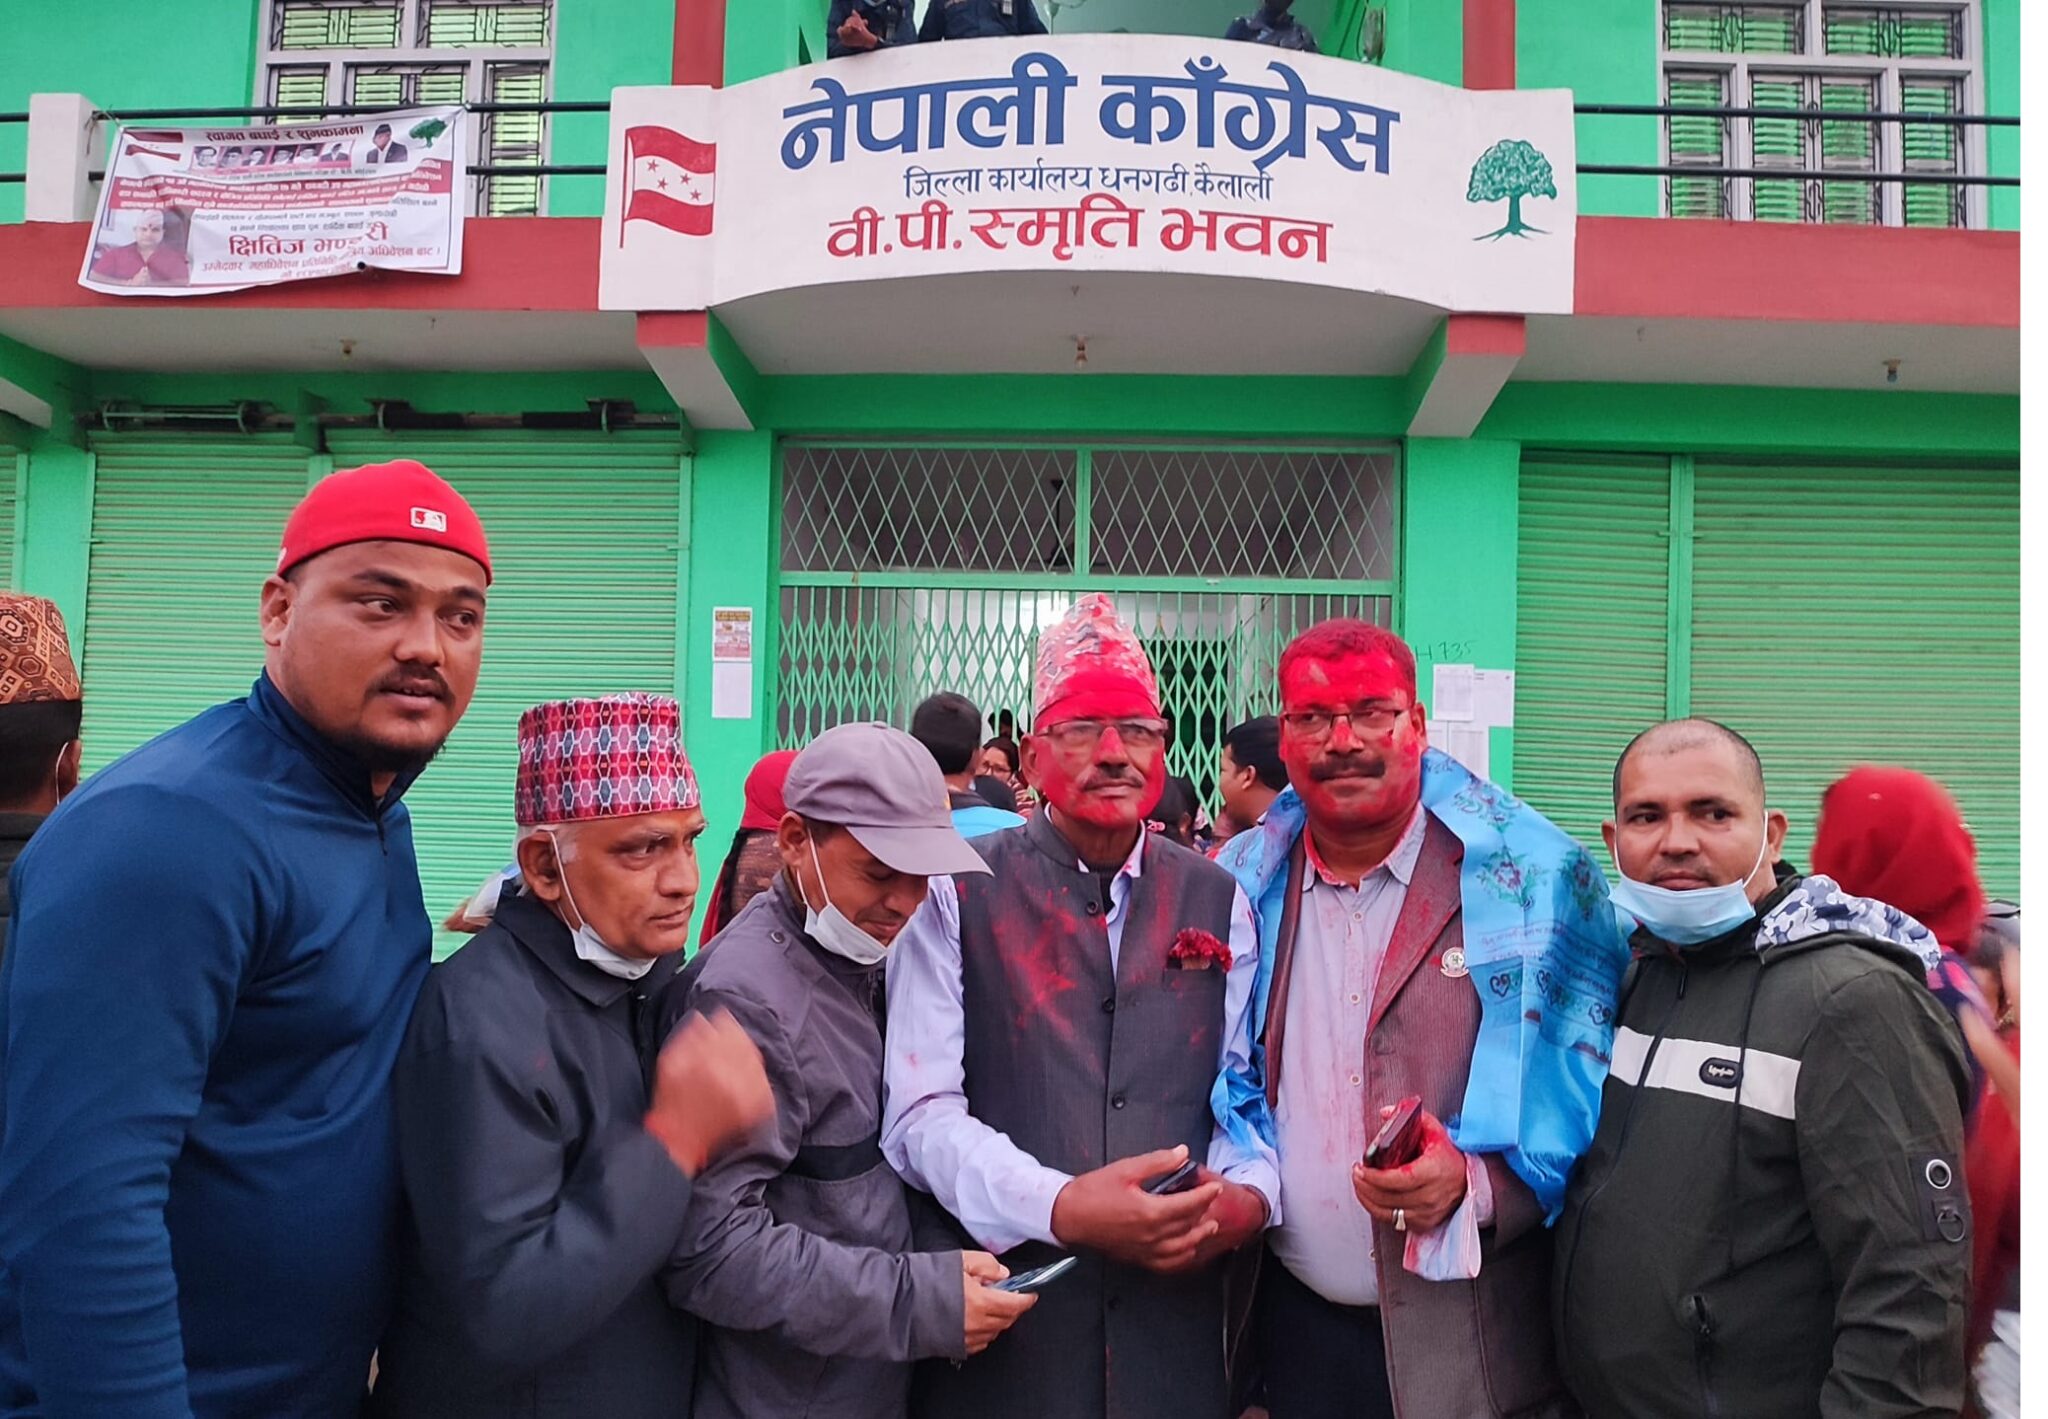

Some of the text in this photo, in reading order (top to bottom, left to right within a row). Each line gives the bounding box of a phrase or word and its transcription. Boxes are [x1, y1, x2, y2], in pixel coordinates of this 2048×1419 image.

[780, 52, 1400, 175] नेपाली काँग्रेस
[903, 165, 983, 199] जिल्ला
[988, 157, 1092, 194] कार्यालय
[228, 234, 307, 257] क्षितिज
[1160, 208, 1334, 264] भवन
